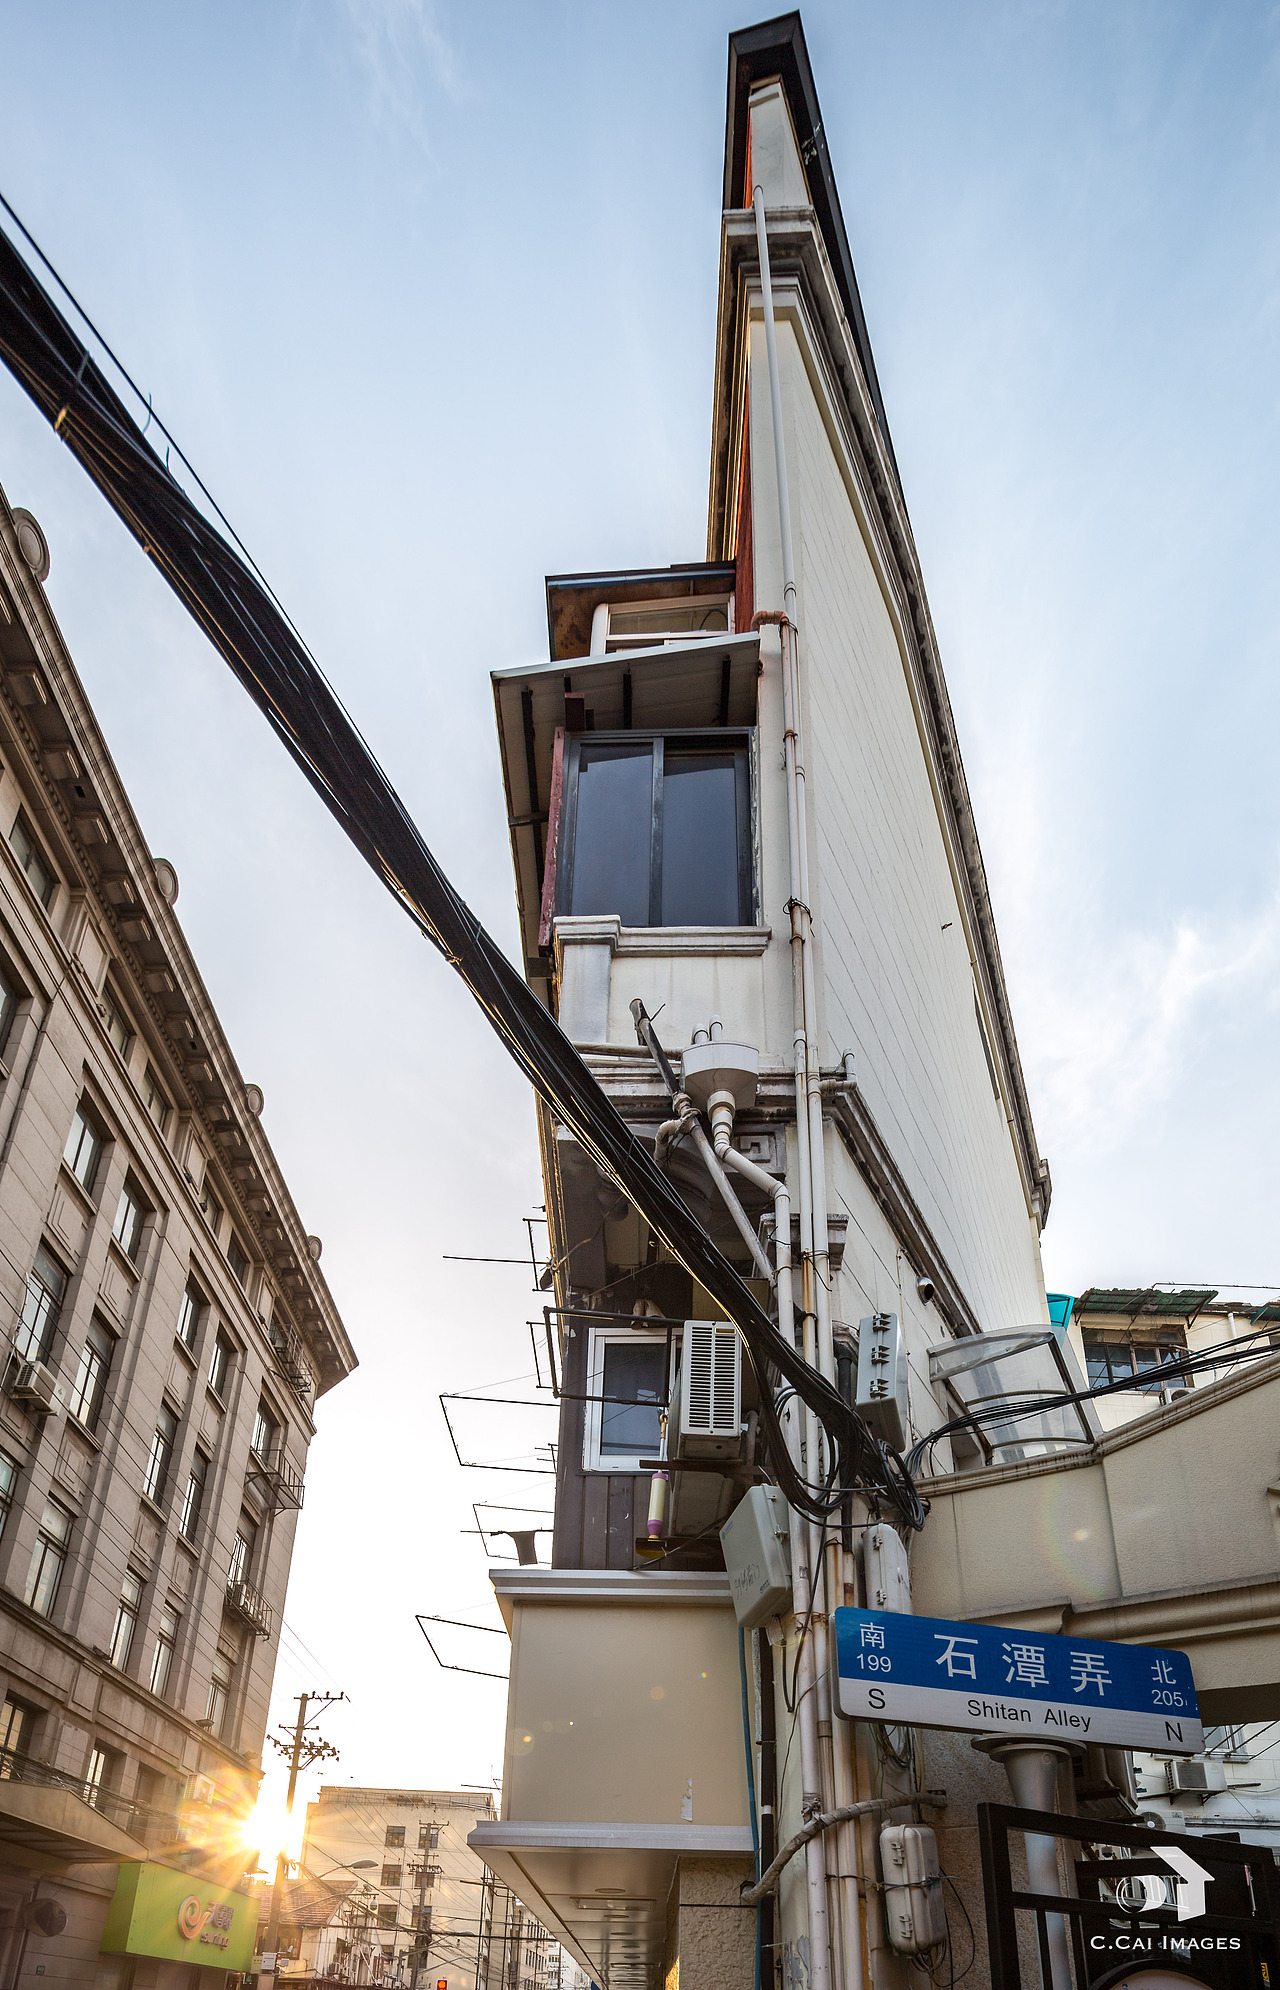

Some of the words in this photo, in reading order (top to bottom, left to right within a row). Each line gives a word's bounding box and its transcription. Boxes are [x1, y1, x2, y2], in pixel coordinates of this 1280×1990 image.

[859, 1622, 885, 1649] 南
[856, 1653, 892, 1673] 199
[934, 1633, 1112, 1696] 石潭弄
[1150, 1659, 1177, 1685] 北
[868, 1688, 886, 1710] S
[1151, 1689, 1184, 1707] 205
[967, 1699, 1032, 1723] Shitan
[1043, 1708, 1091, 1732] Alley
[1164, 1720, 1184, 1743] N
